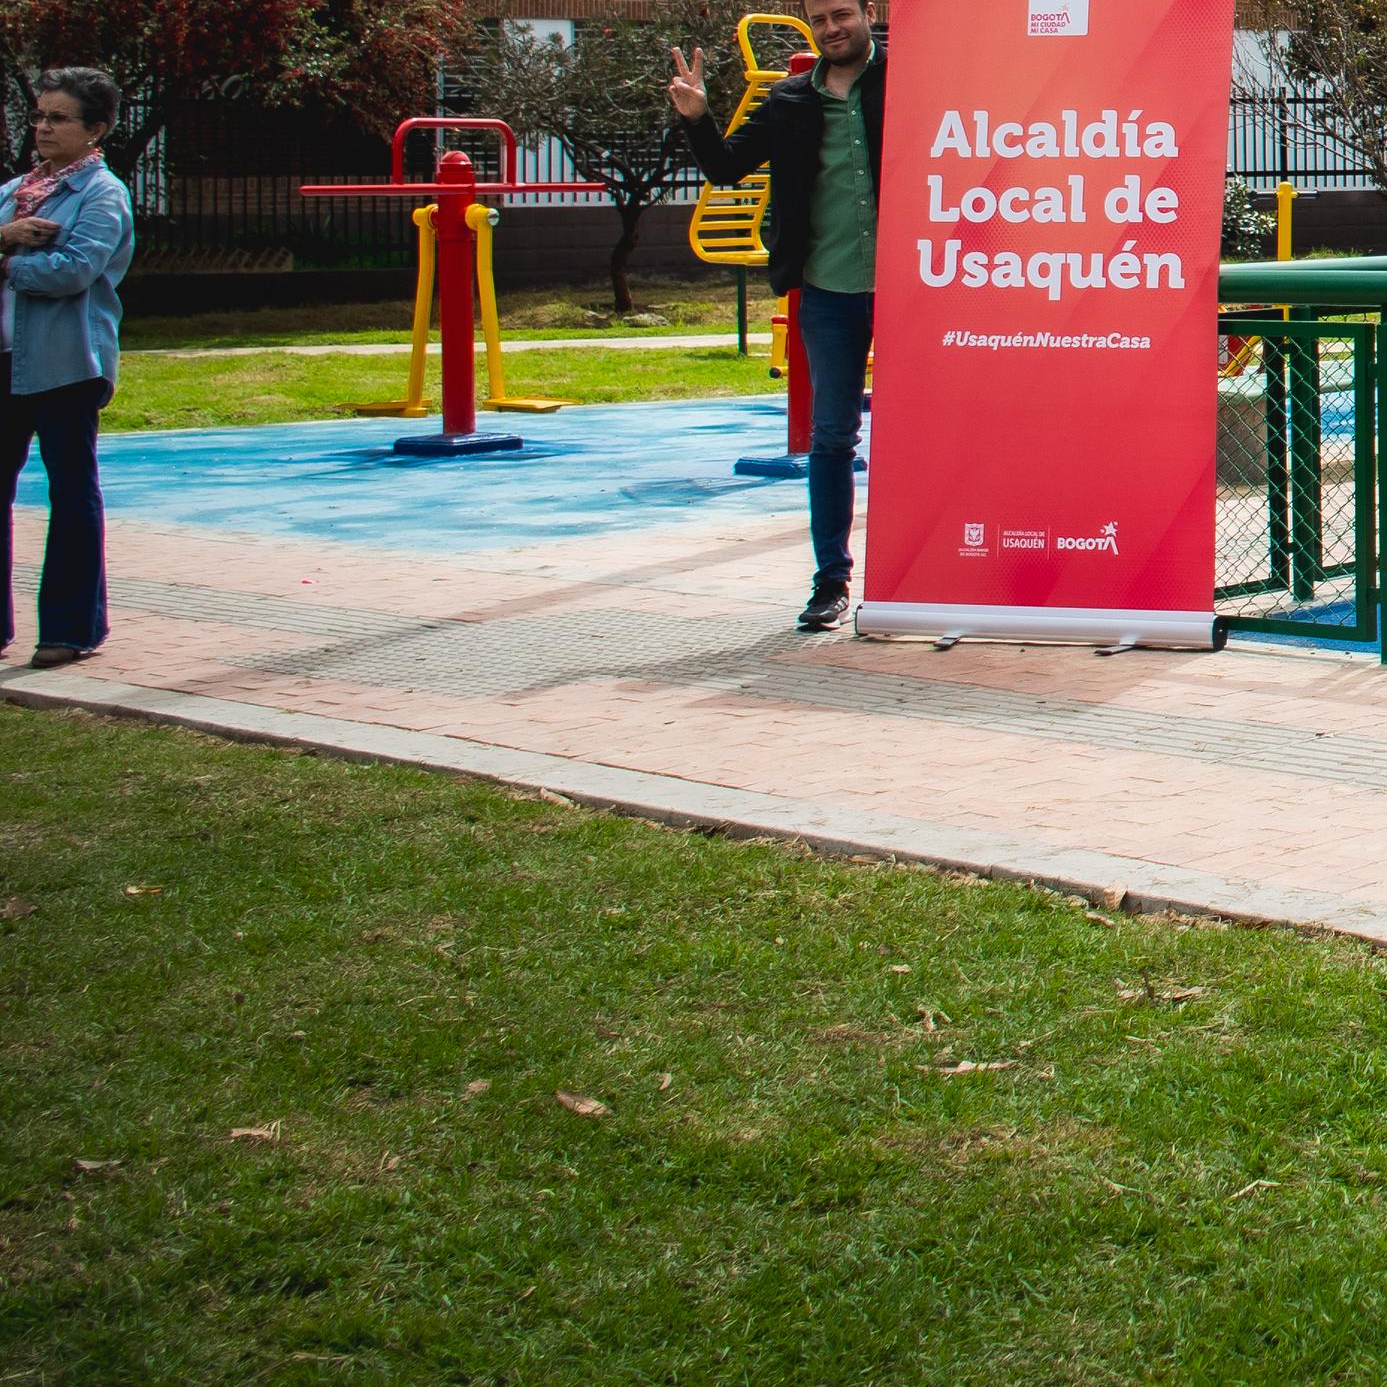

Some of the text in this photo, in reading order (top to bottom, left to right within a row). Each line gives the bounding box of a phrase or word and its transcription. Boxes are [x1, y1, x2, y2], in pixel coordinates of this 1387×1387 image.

[930, 109, 1179, 158] Alcaldía
[927, 174, 1179, 224] Local de
[917, 239, 1185, 301] Usaquén
[942, 330, 1151, 351] #UsaquénNuestraCasa
[1003, 536, 1045, 549] USAQUÉN
